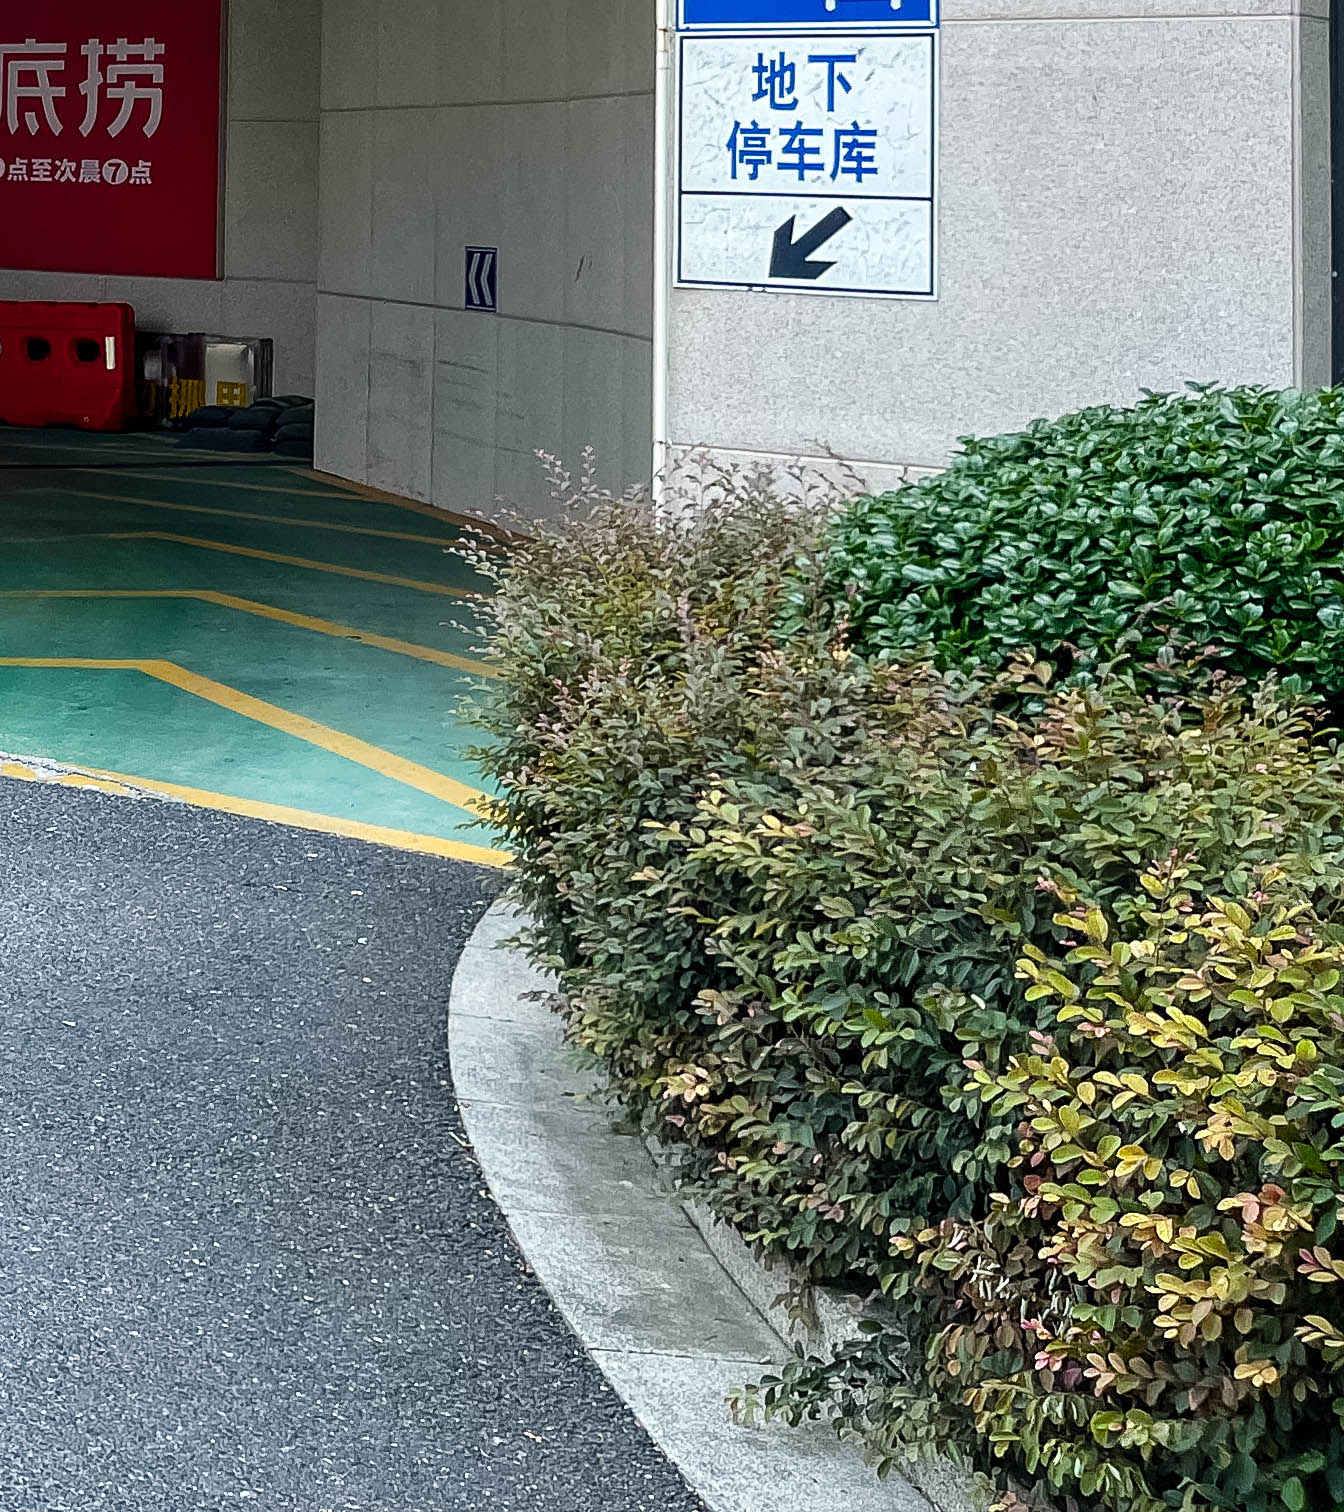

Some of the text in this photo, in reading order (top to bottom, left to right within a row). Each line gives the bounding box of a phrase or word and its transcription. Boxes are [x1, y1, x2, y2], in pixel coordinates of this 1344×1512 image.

[752, 51, 857, 113] 地下
[725, 120, 879, 183] 停车库
